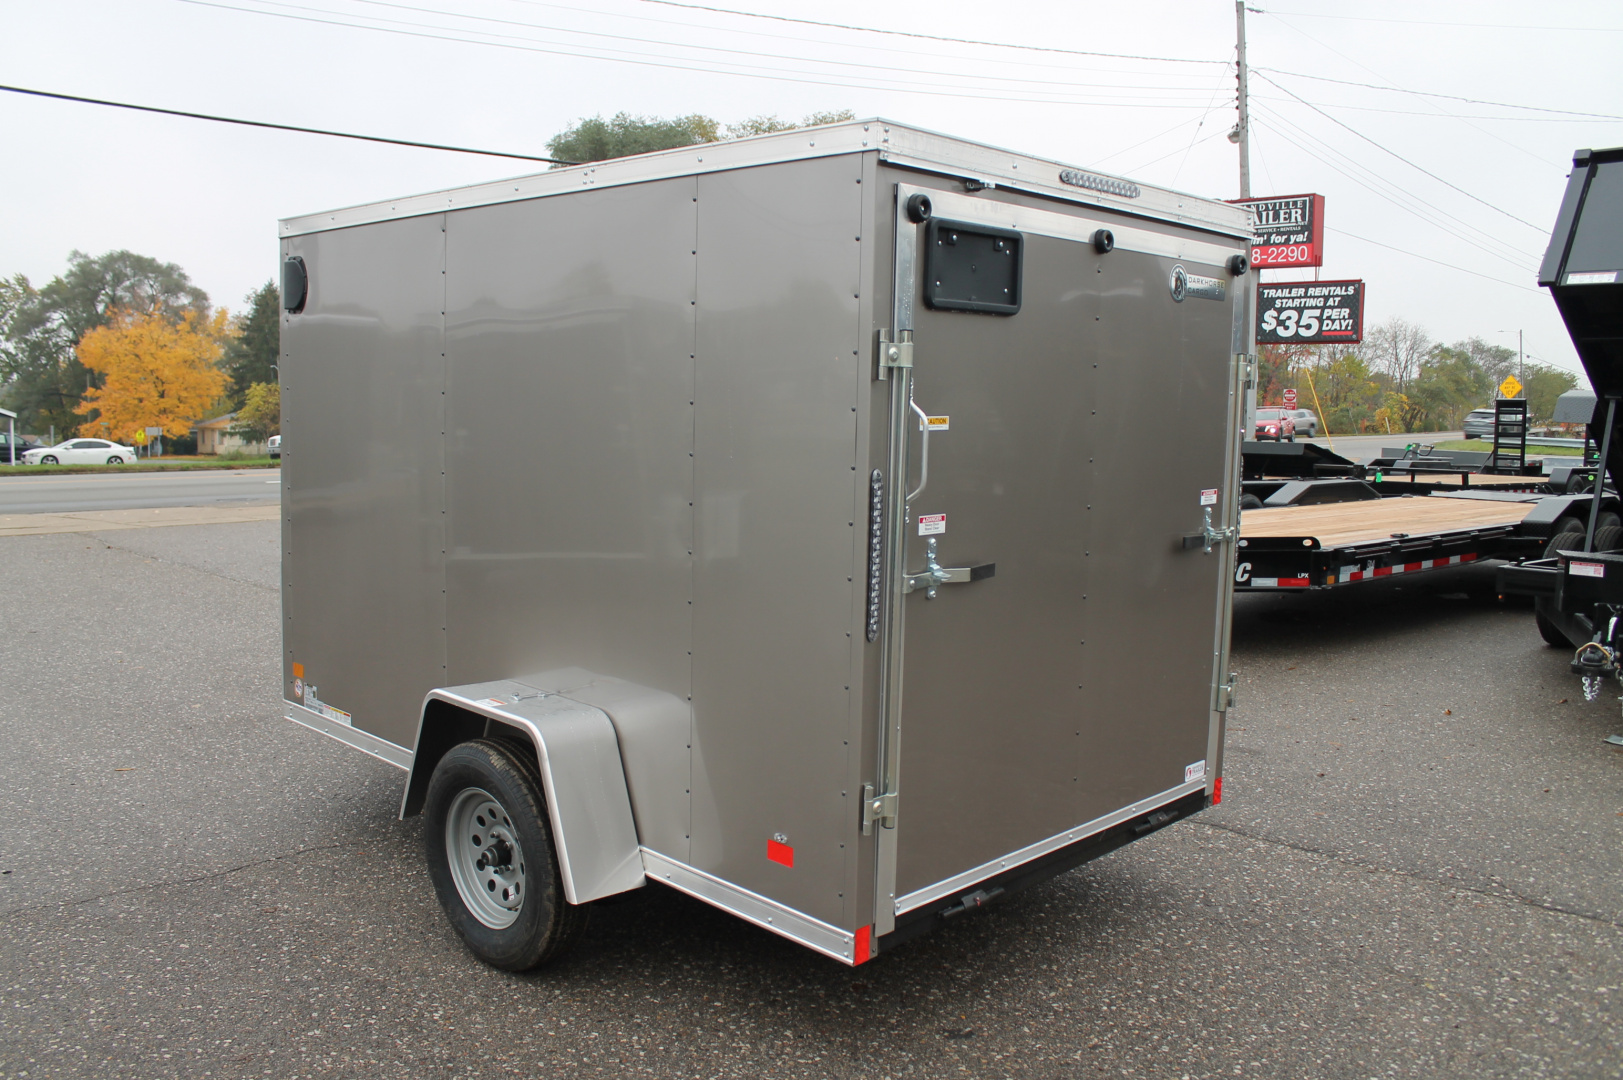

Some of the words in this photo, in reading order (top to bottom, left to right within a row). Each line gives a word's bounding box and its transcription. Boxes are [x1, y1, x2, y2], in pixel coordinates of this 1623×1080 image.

[1251, 234, 1267, 245] in'
[1270, 233, 1288, 244] for
[1289, 231, 1309, 244] ya!
[1251, 245, 1308, 263] 8-2290
[1263, 288, 1307, 298] TRAILER
[1307, 285, 1355, 297] RENTALS
[1275, 297, 1324, 308] STARTING
[1326, 297, 1342, 306] AT
[1323, 308, 1350, 319] PER
[1261, 308, 1321, 337] $35
[1322, 319, 1353, 330] DAY!
